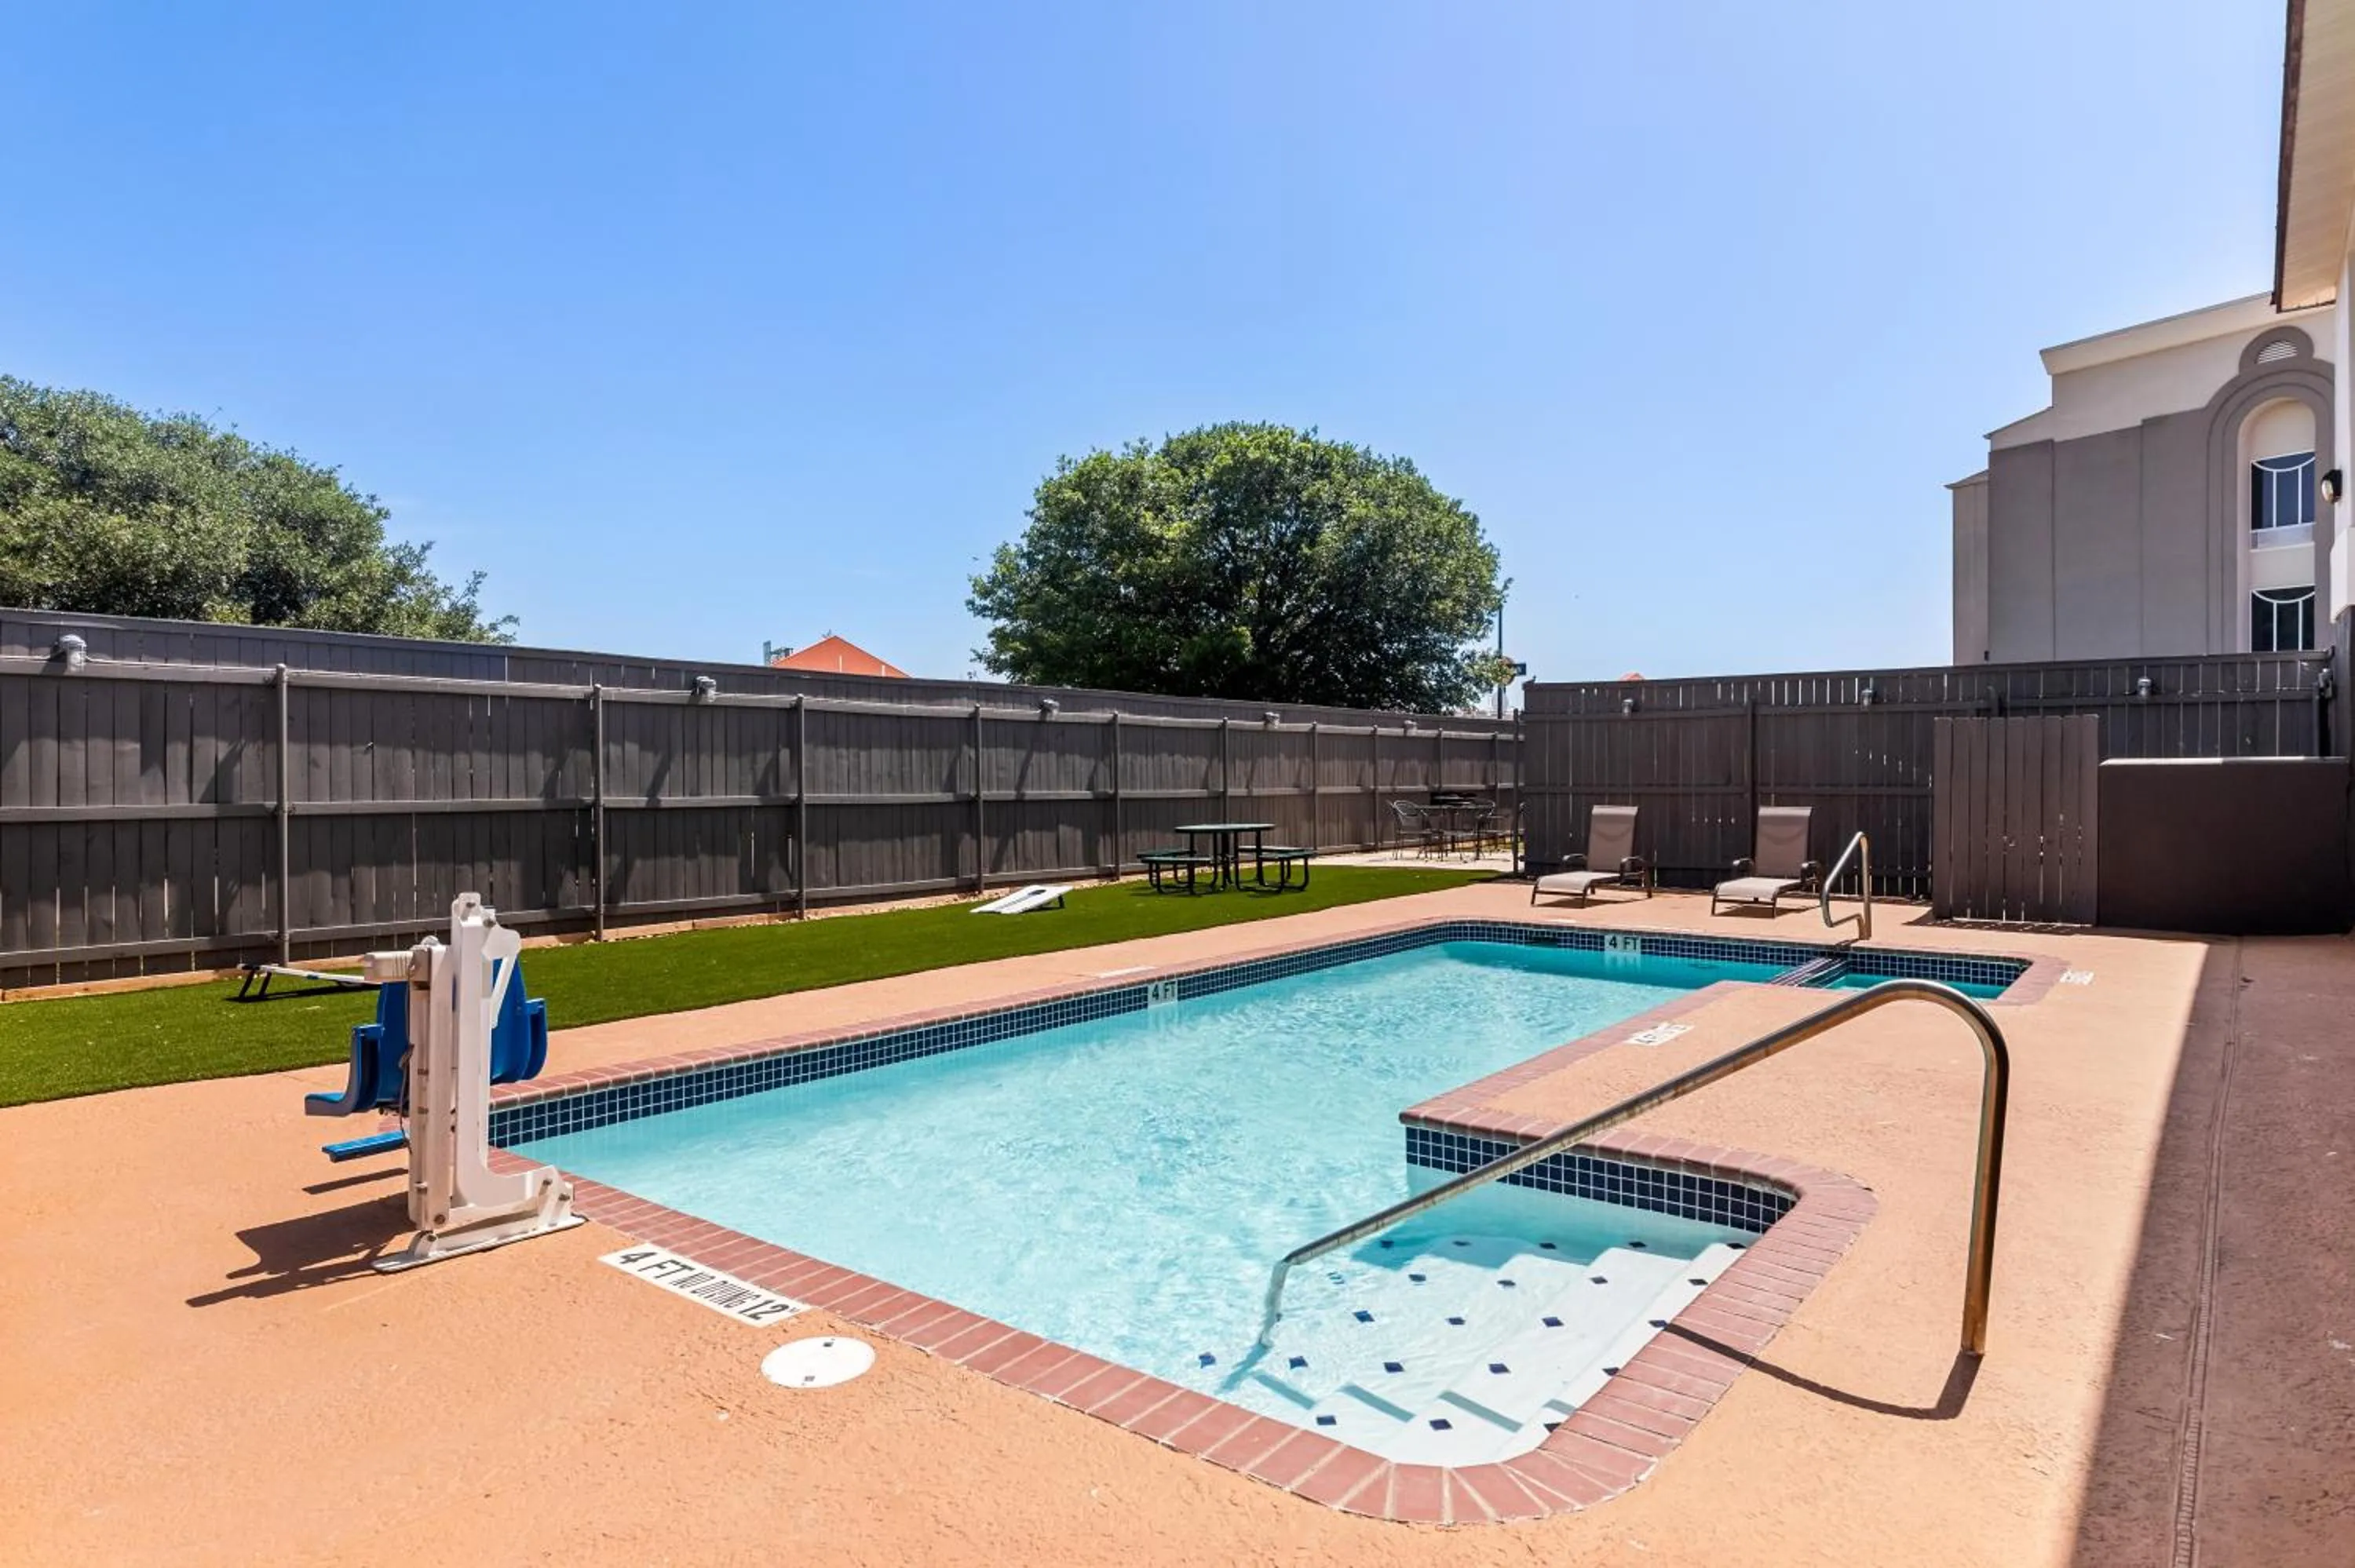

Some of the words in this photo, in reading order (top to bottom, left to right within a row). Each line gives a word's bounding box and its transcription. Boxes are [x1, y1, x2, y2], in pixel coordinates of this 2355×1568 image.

[1609, 935, 1617, 949] 4
[1623, 936, 1639, 950] FT
[1152, 983, 1159, 1000] 4
[1163, 981, 1177, 999] FT
[619, 1252, 658, 1264] 4
[637, 1259, 696, 1279] FT
